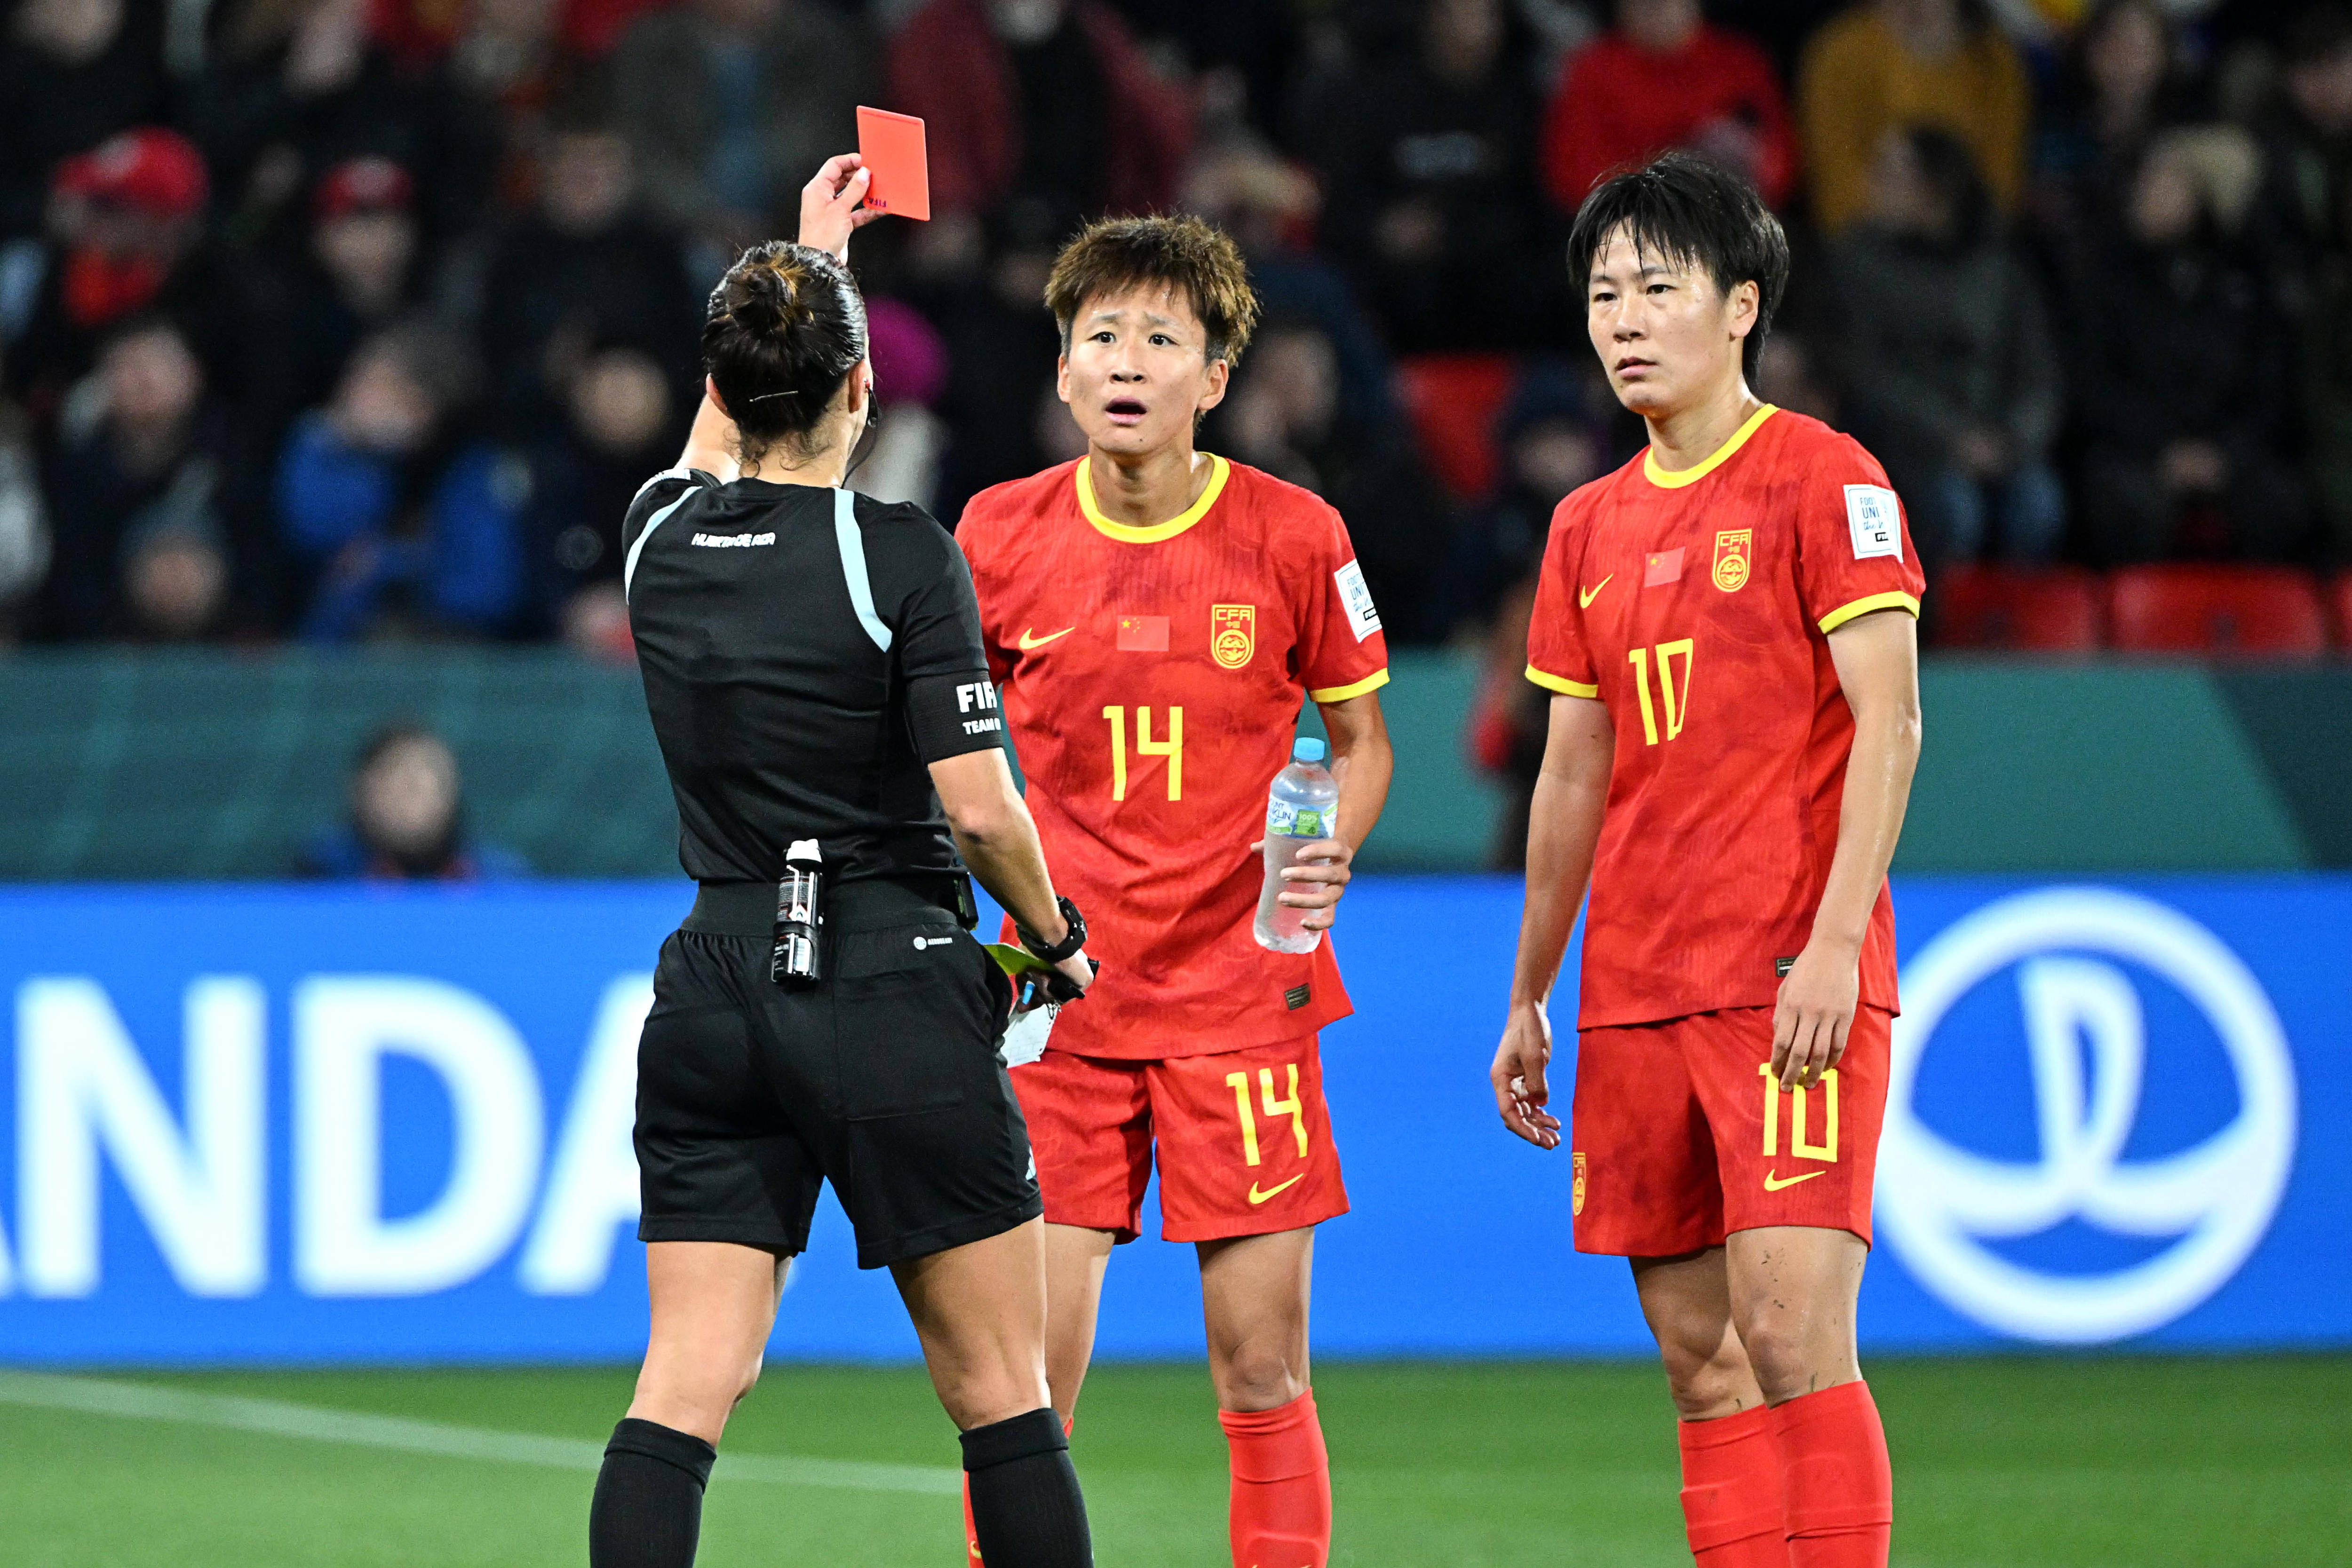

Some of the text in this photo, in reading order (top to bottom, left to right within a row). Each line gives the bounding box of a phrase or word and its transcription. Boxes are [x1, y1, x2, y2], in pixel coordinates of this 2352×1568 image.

[868, 198, 886, 207] FIFA
[734, 533, 752, 547] DE
[1719, 534, 1749, 546] CFA
[1216, 609, 1251, 621] CFA
[1629, 638, 1693, 745] 10
[962, 718, 995, 735] TEAM
[1103, 705, 1183, 801] 14
[0, 974, 654, 1299] NDA
[1225, 1063, 1308, 1166] 14
[1758, 1062, 1838, 1163] 10
